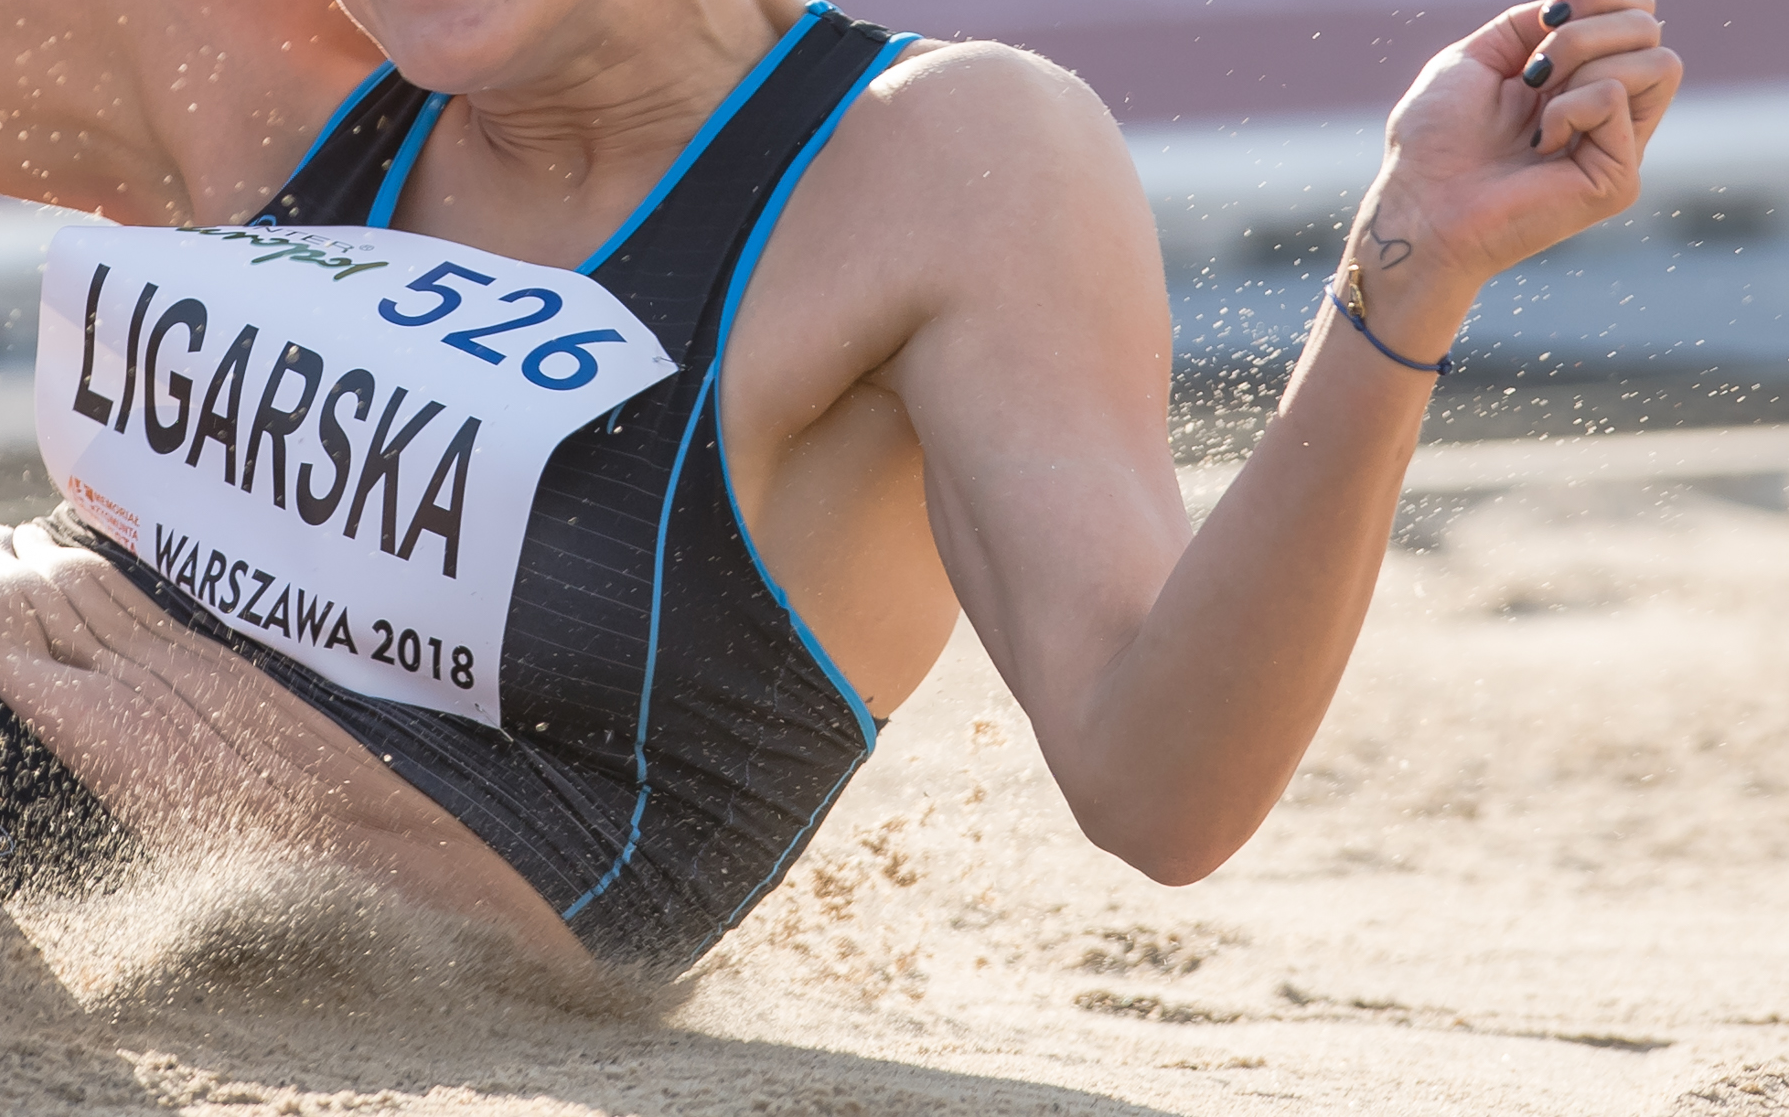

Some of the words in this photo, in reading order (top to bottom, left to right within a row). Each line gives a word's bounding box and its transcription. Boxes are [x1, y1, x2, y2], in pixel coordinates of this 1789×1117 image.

[252, 225, 354, 254] NTER
[377, 261, 628, 390] 526
[72, 262, 482, 580] LIGARSKA
[155, 522, 358, 655] WARSZAWA
[371, 620, 475, 689] 2018
